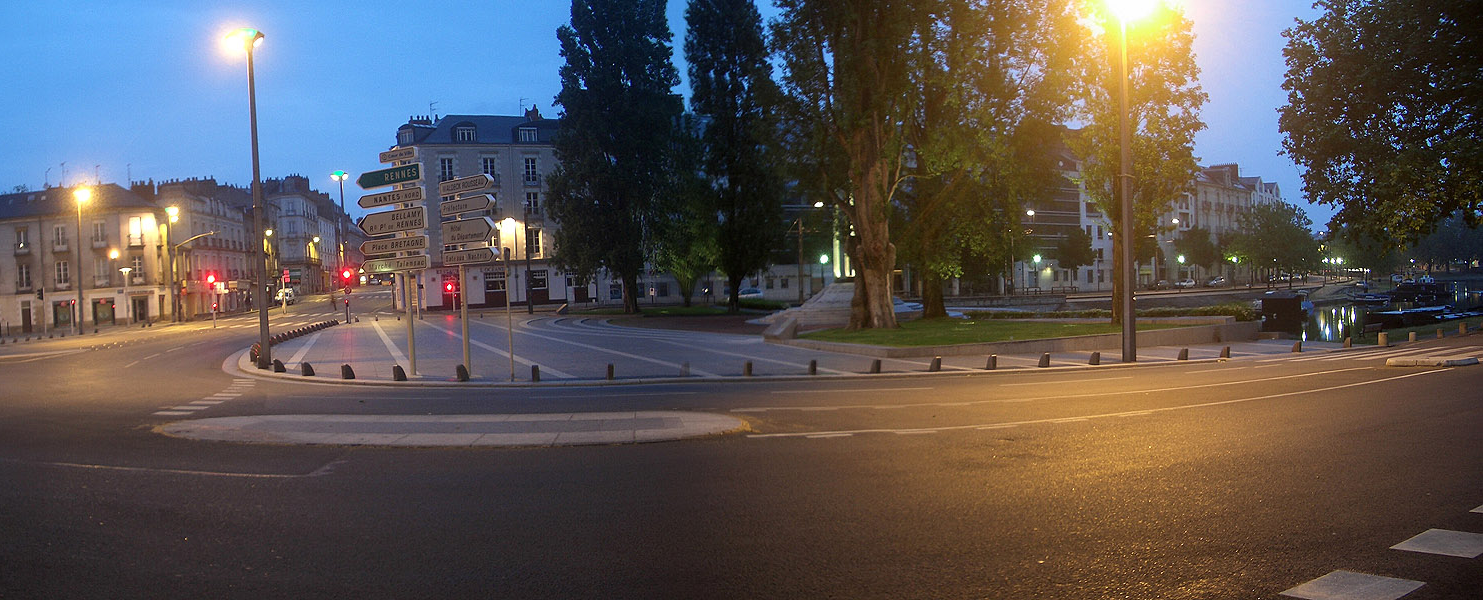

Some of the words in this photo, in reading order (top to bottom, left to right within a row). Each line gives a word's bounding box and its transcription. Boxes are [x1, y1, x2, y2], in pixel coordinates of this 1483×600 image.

[384, 168, 417, 181] RENNES
[392, 211, 421, 220] BELLAMY
[397, 219, 422, 228] RENNES
[391, 238, 423, 248] BRETAGNE
